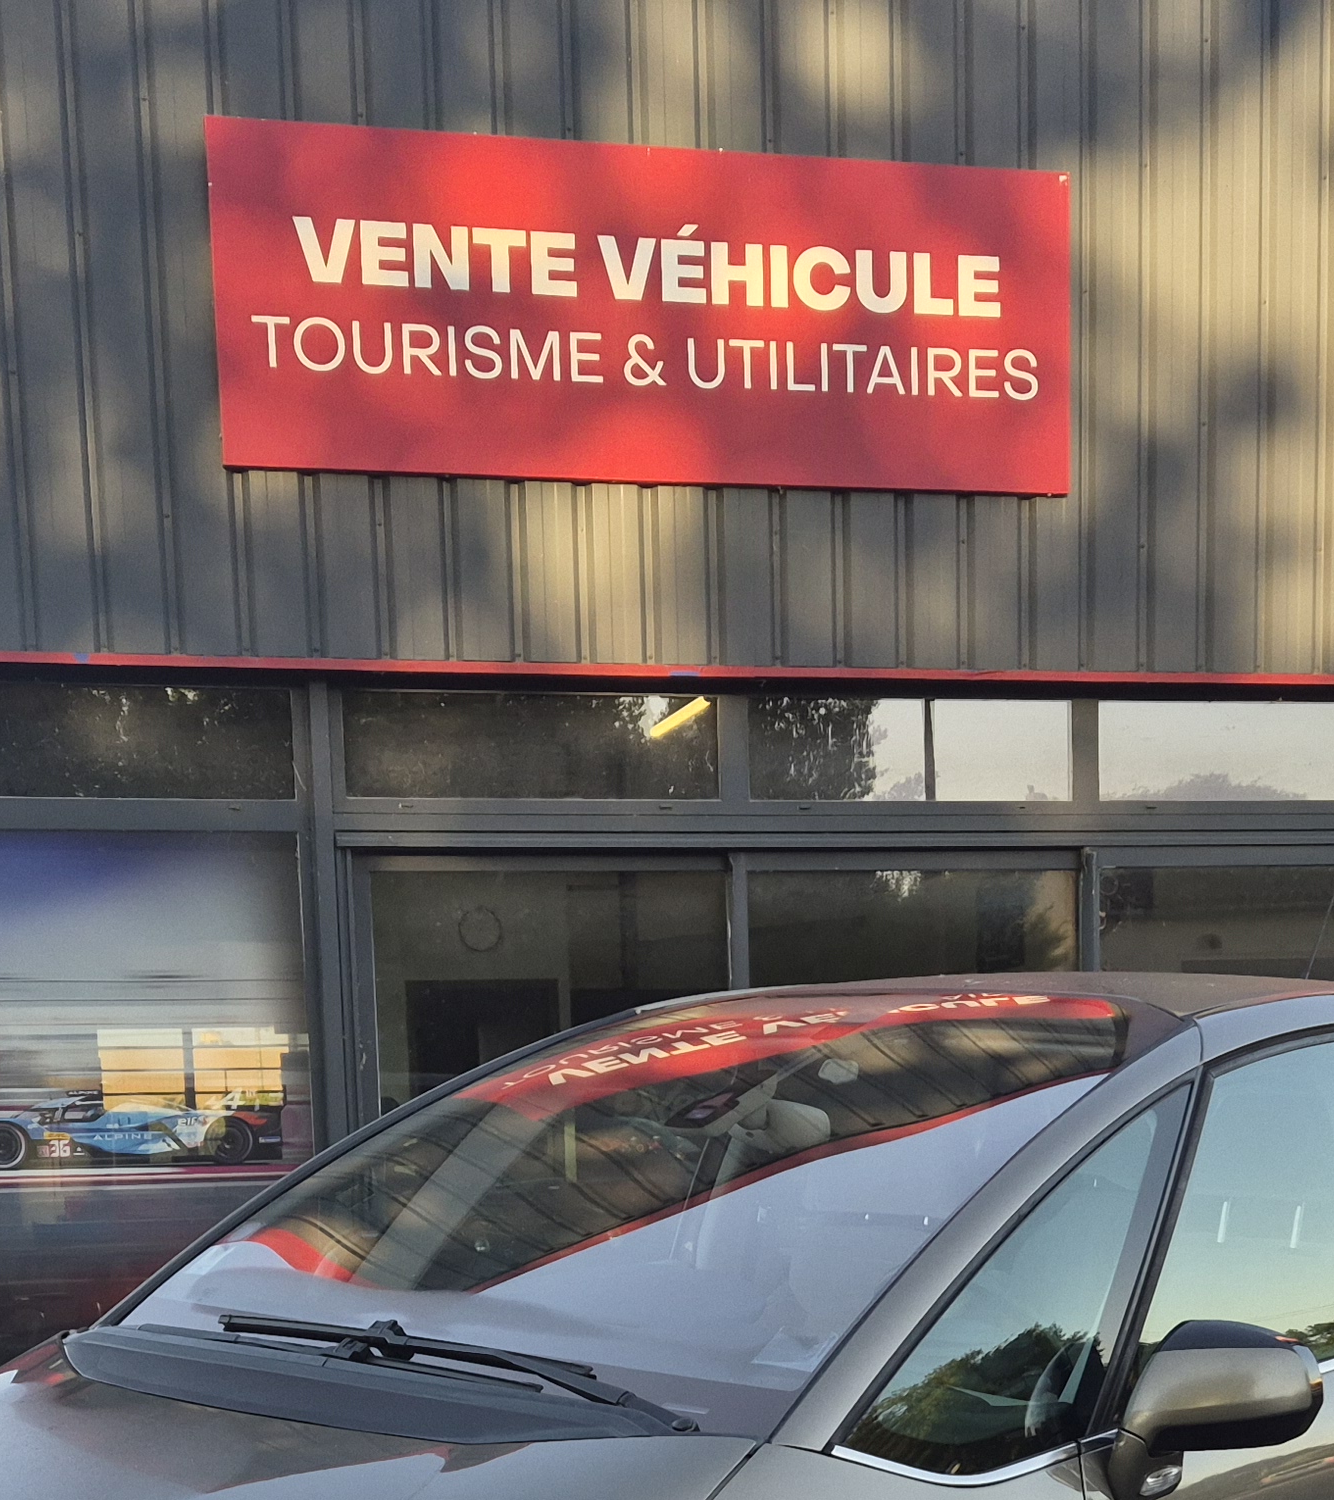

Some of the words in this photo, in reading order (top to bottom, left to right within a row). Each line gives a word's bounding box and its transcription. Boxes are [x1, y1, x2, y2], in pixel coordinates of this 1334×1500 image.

[292, 215, 578, 297] VENTE
[597, 224, 1002, 318] VÉHICULE
[251, 314, 604, 385] TOURISME
[623, 334, 666, 388] &
[687, 337, 1040, 401] UTILITAIRES
[93, 1133, 153, 1141] ALPINE
